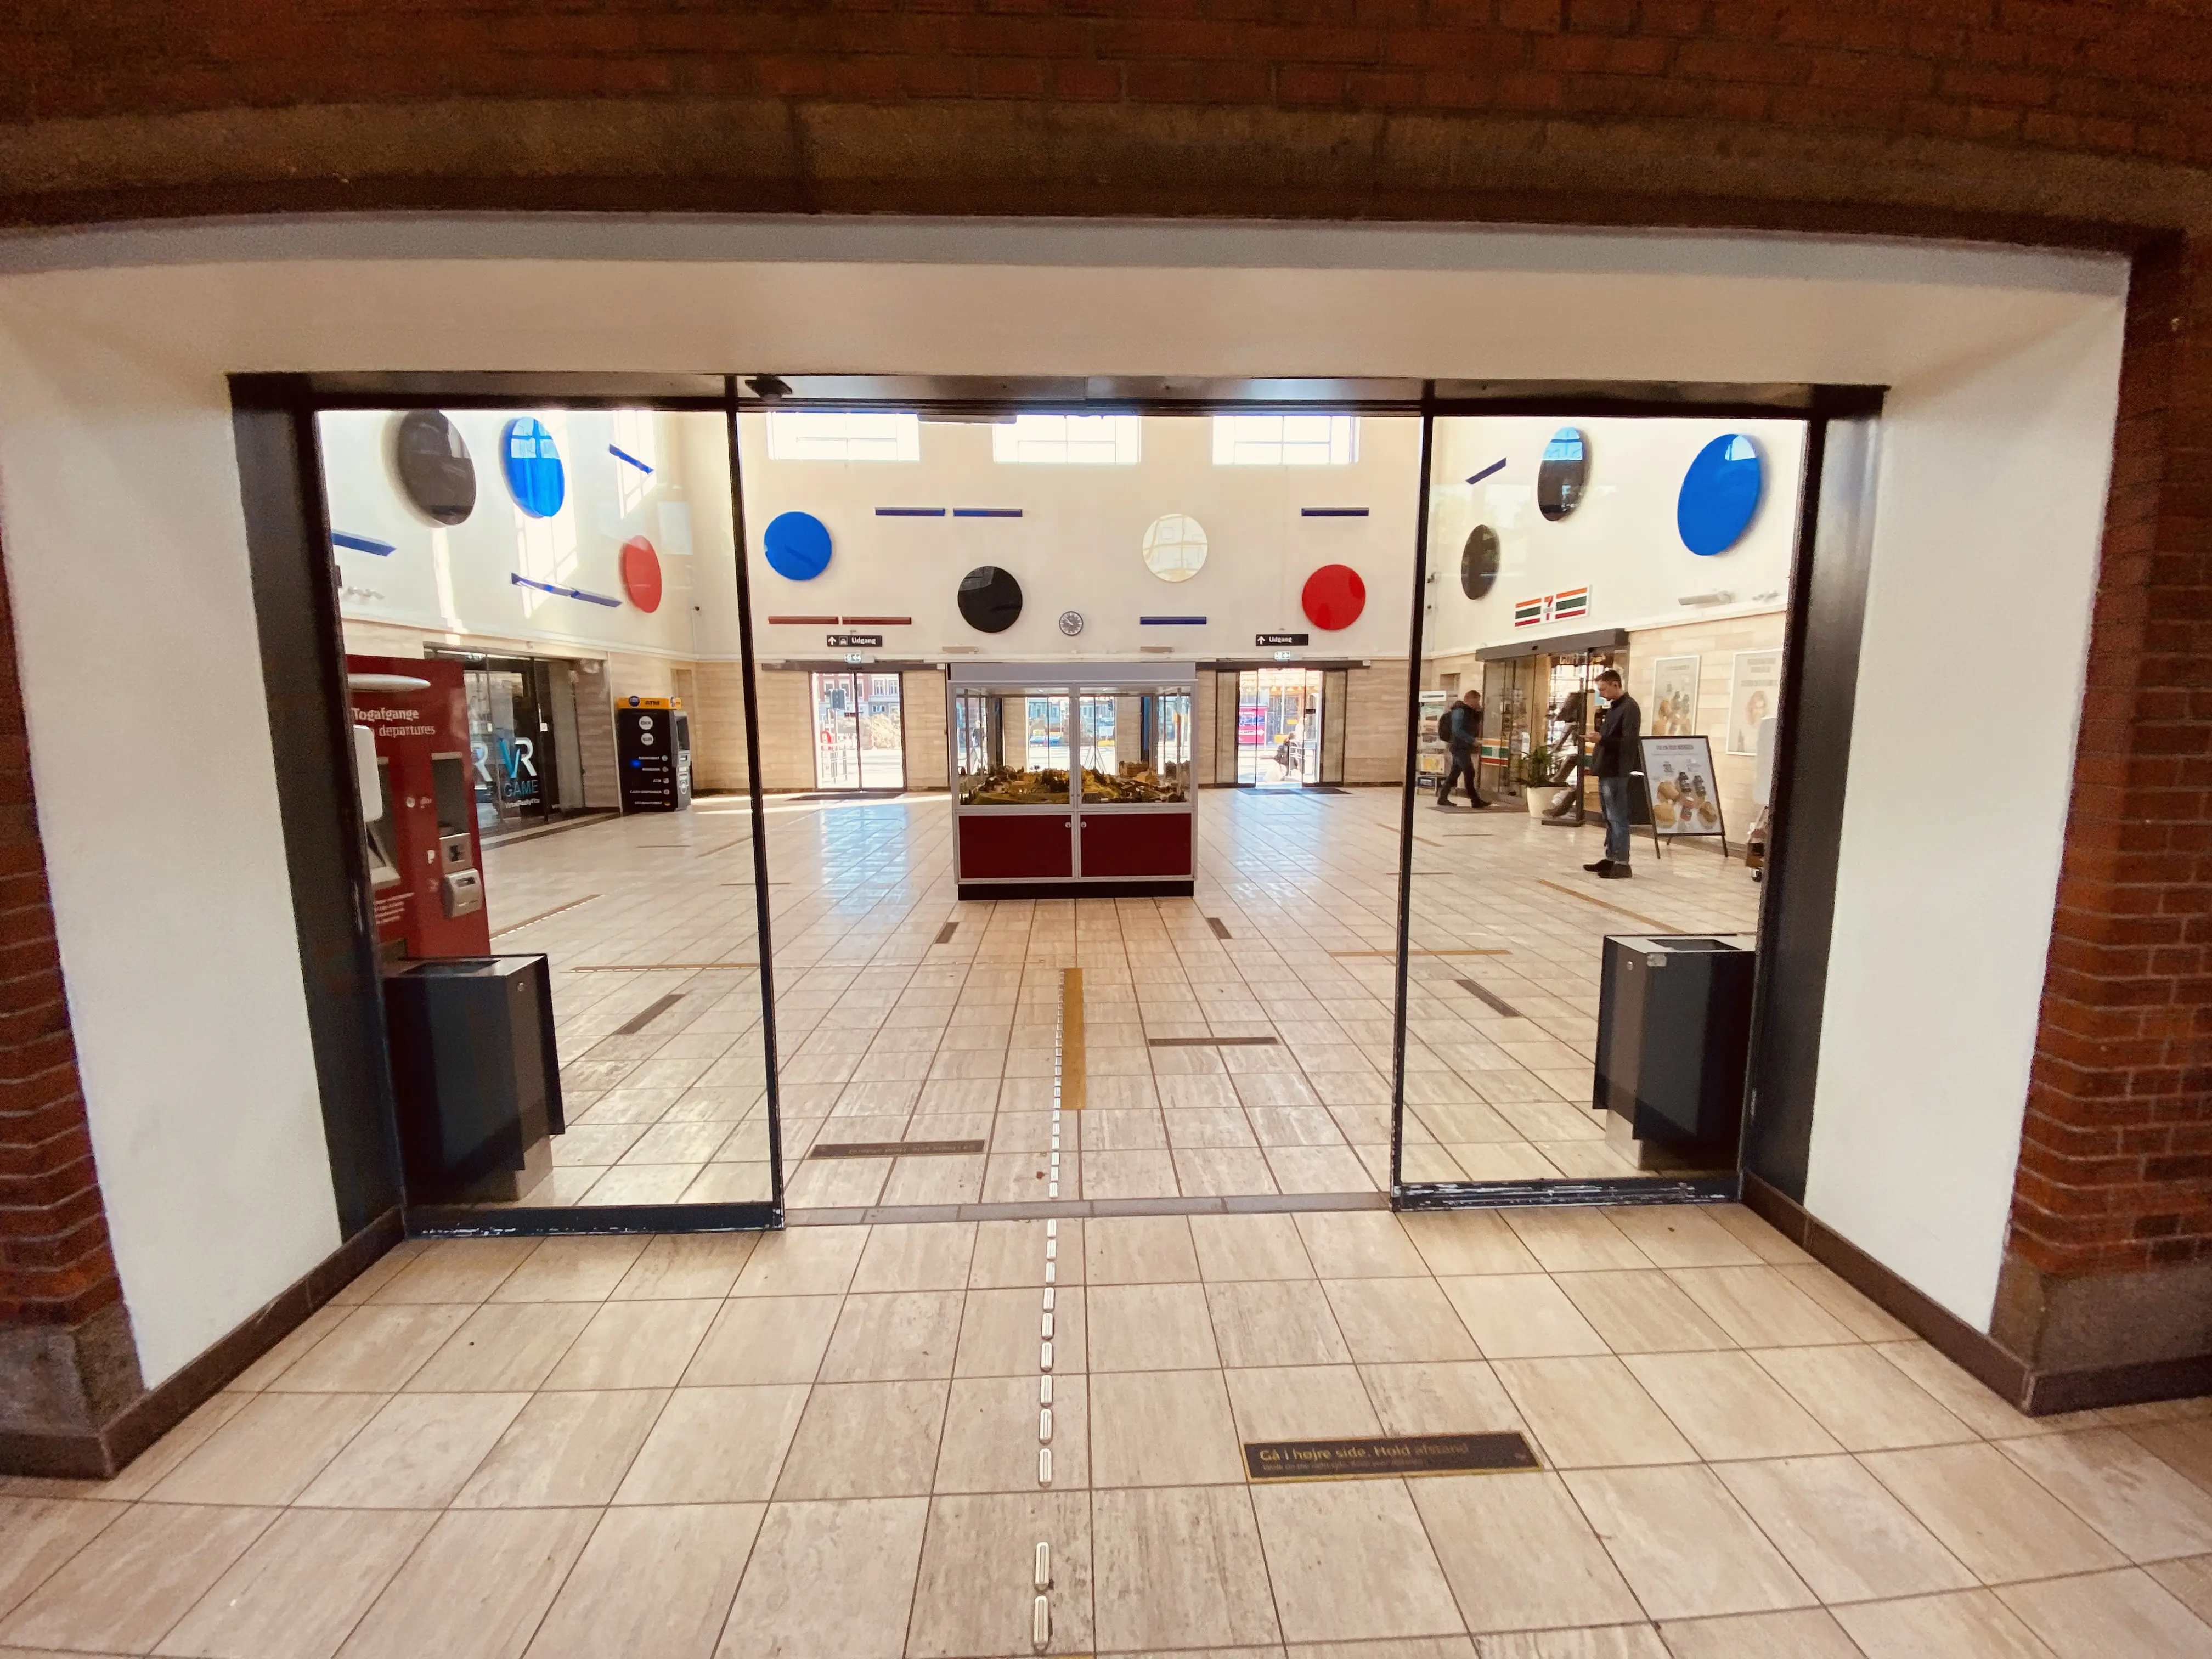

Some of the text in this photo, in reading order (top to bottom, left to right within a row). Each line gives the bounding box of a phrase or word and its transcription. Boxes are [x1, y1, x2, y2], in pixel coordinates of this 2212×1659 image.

[351, 707, 419, 722] Togafgange
[379, 724, 436, 738] departures
[500, 737, 537, 778] VR
[504, 780, 539, 797] GAME
[1260, 1448, 1280, 1461] Gå
[1293, 1448, 1331, 1461] højre
[1373, 1446, 1410, 1457] Hold
